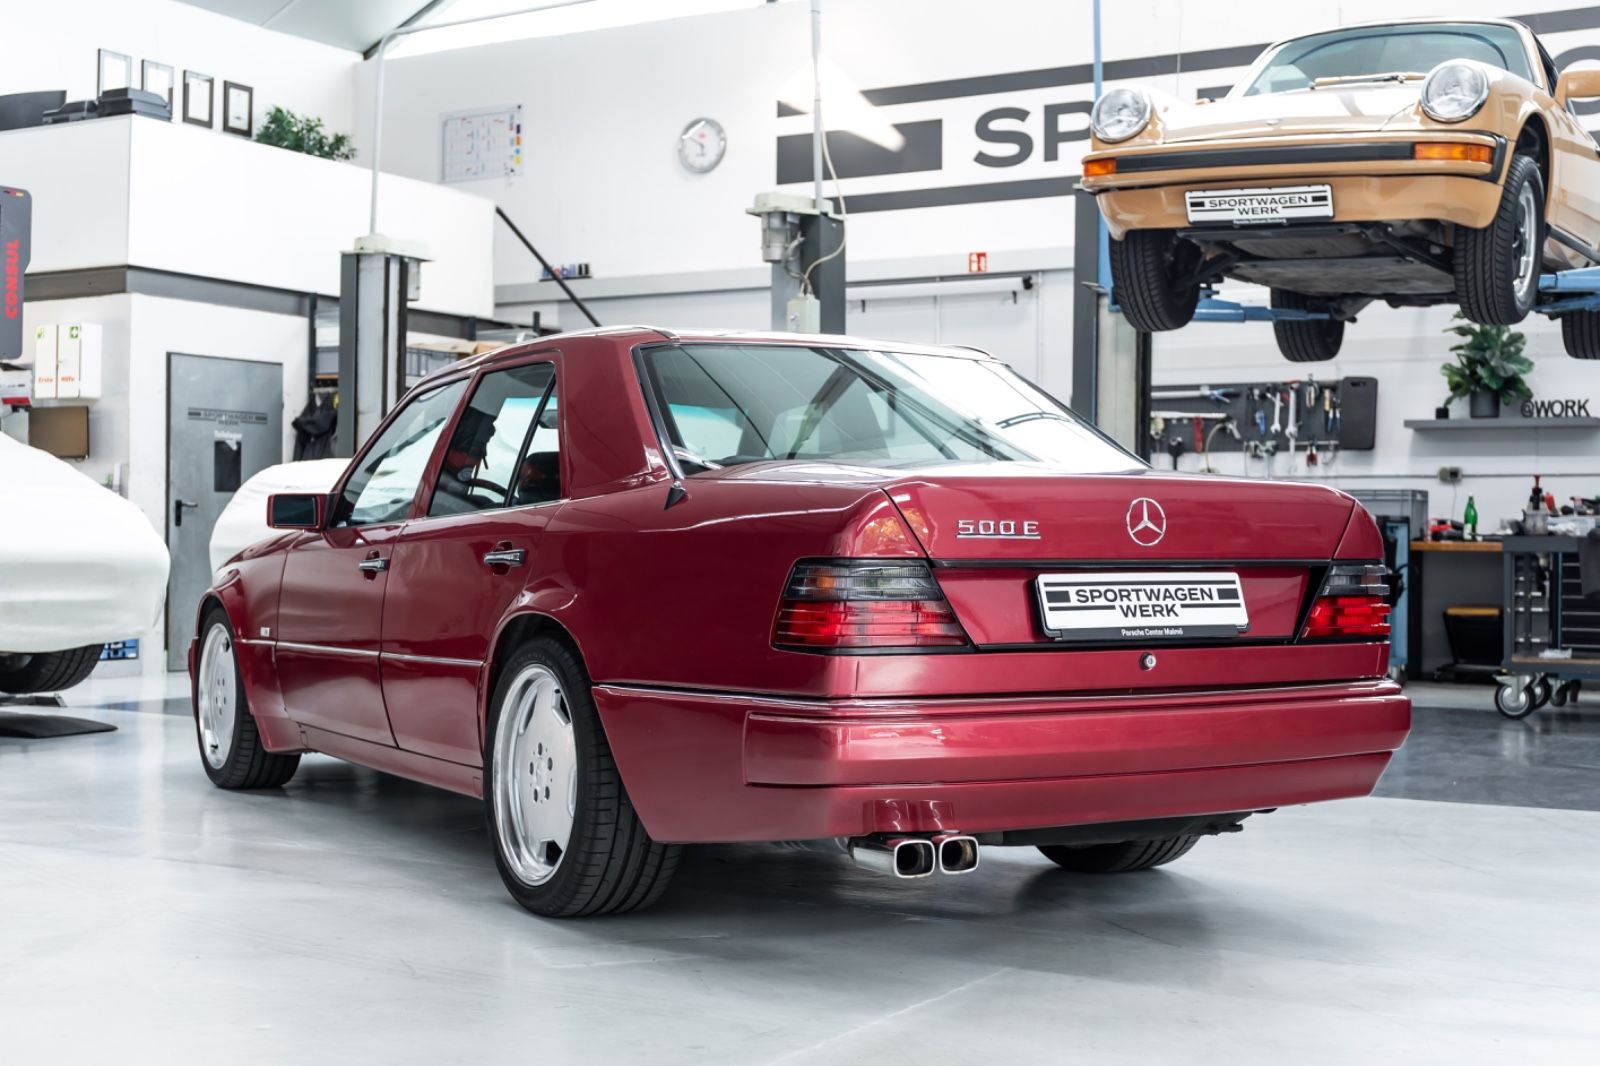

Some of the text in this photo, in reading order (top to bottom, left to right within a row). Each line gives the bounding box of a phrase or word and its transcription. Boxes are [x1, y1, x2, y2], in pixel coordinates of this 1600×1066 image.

[973, 100, 1094, 168] SP
[1209, 196, 1307, 207] SPORTWAGEN
[1237, 206, 1280, 216] WERK
[5, 239, 19, 319] CONSUL
[1520, 399, 1591, 418] @WORK
[1023, 520, 1040, 536] E
[1075, 587, 1214, 603] SPORTWAGEN
[1119, 603, 1180, 619] WERK
[1121, 628, 1145, 637] Porsche
[1144, 628, 1164, 636] Center
